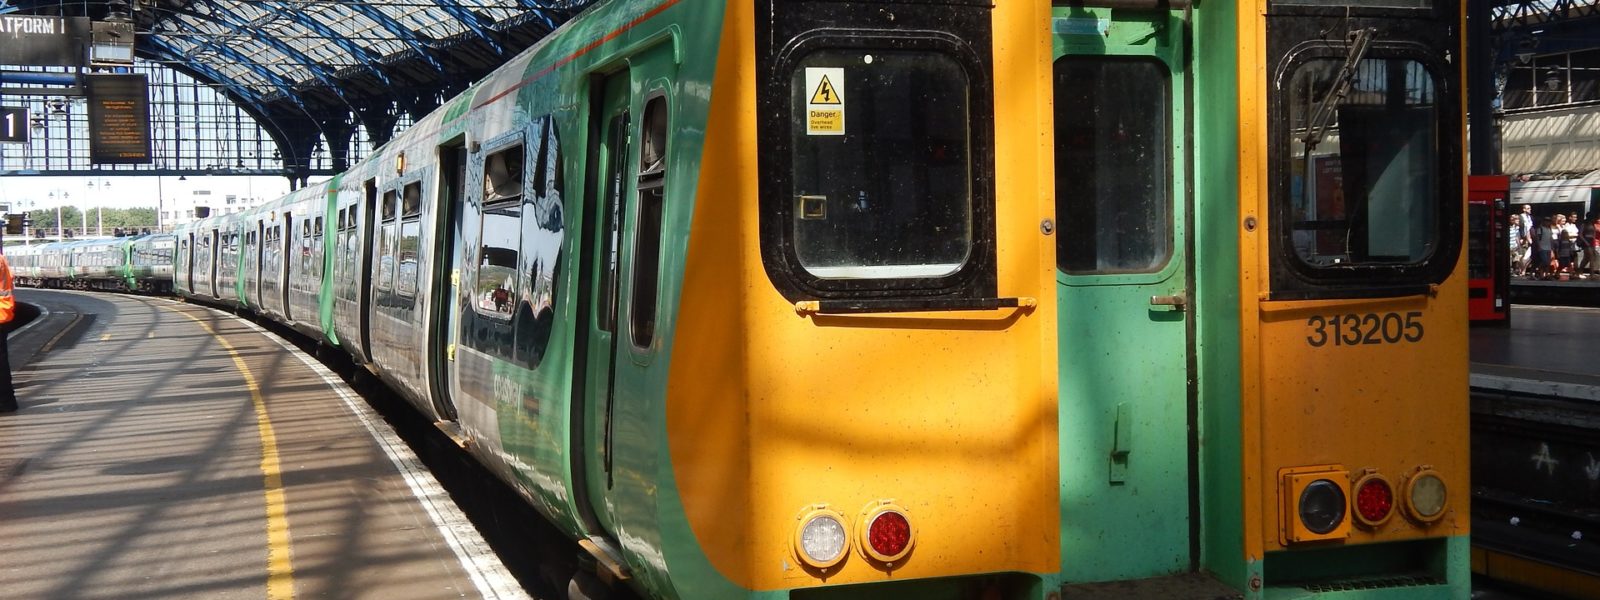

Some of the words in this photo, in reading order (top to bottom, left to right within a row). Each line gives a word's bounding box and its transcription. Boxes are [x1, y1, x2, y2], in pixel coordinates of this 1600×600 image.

[5, 113, 14, 137] 1
[810, 111, 836, 119] Danger
[1307, 311, 1424, 347] 313205
